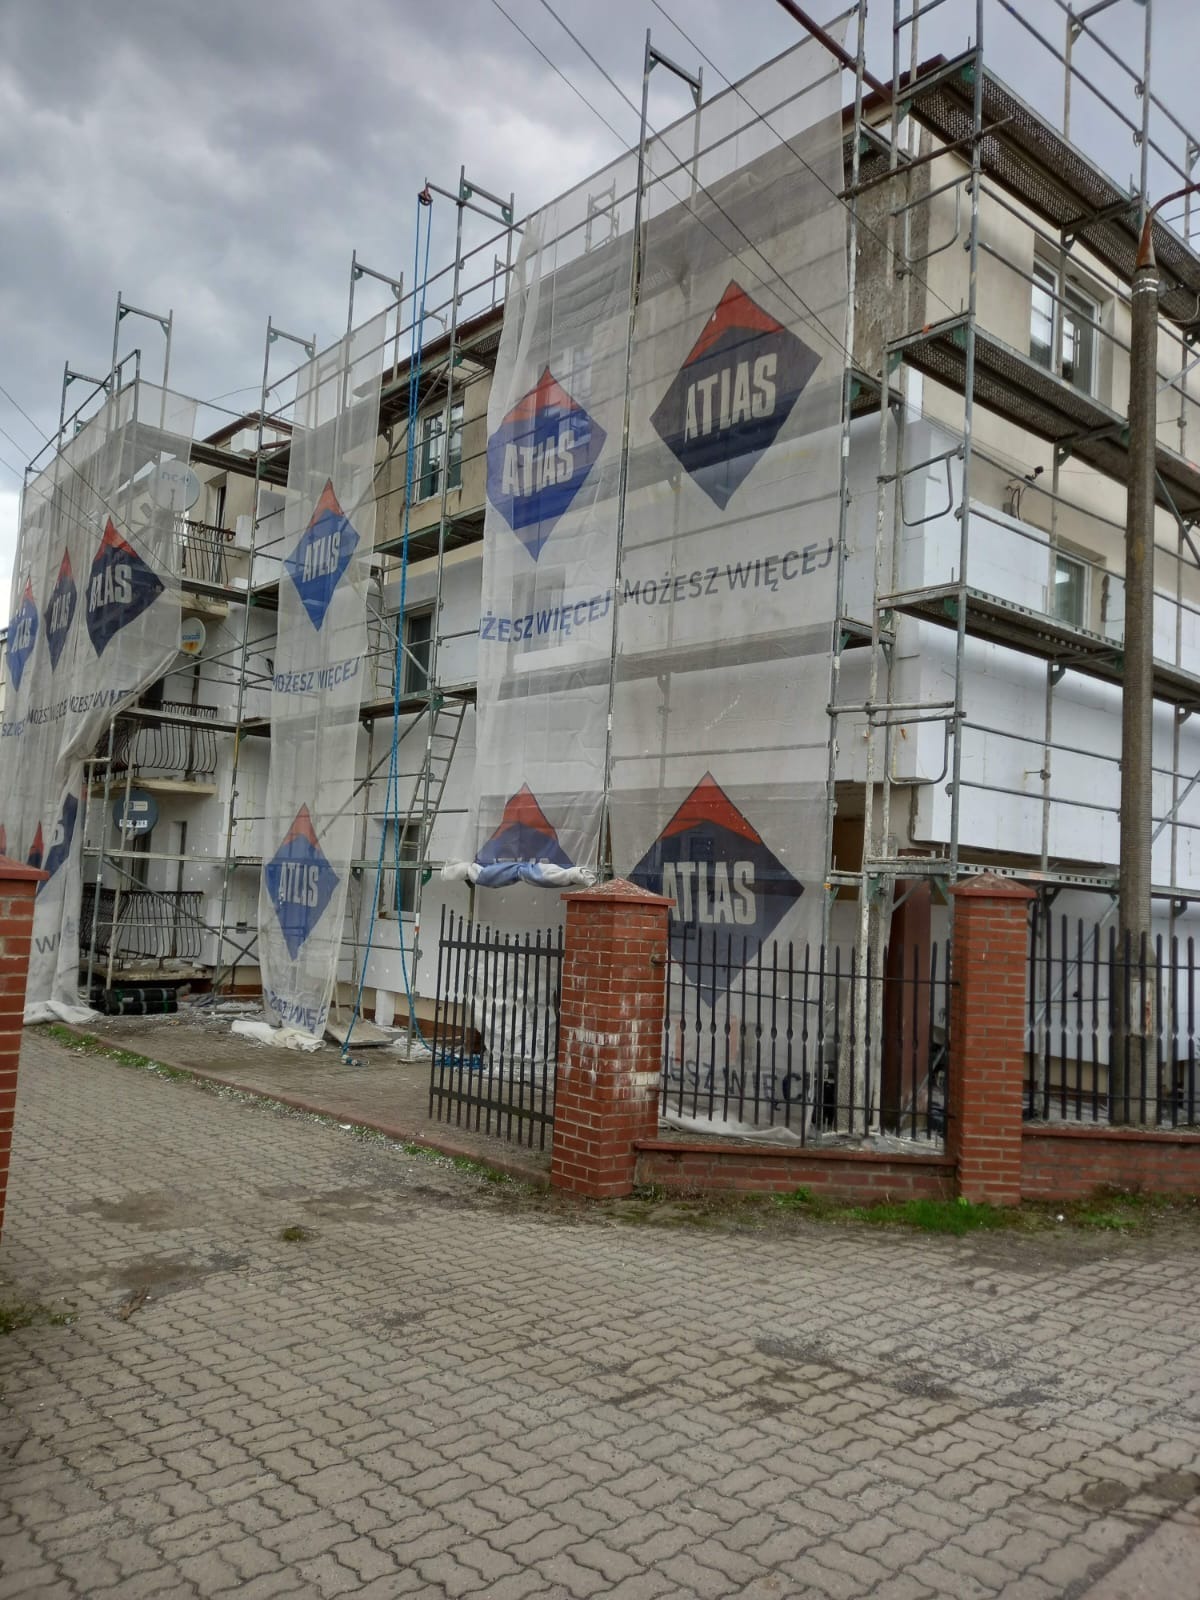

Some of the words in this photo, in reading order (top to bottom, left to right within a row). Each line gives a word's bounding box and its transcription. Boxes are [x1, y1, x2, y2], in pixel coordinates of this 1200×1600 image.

[624, 565, 719, 606] MOŻESZ
[725, 537, 834, 592] WIĘCEJ
[537, 589, 612, 635] WIĘCEJ
[662, 860, 757, 925] ATLAS
